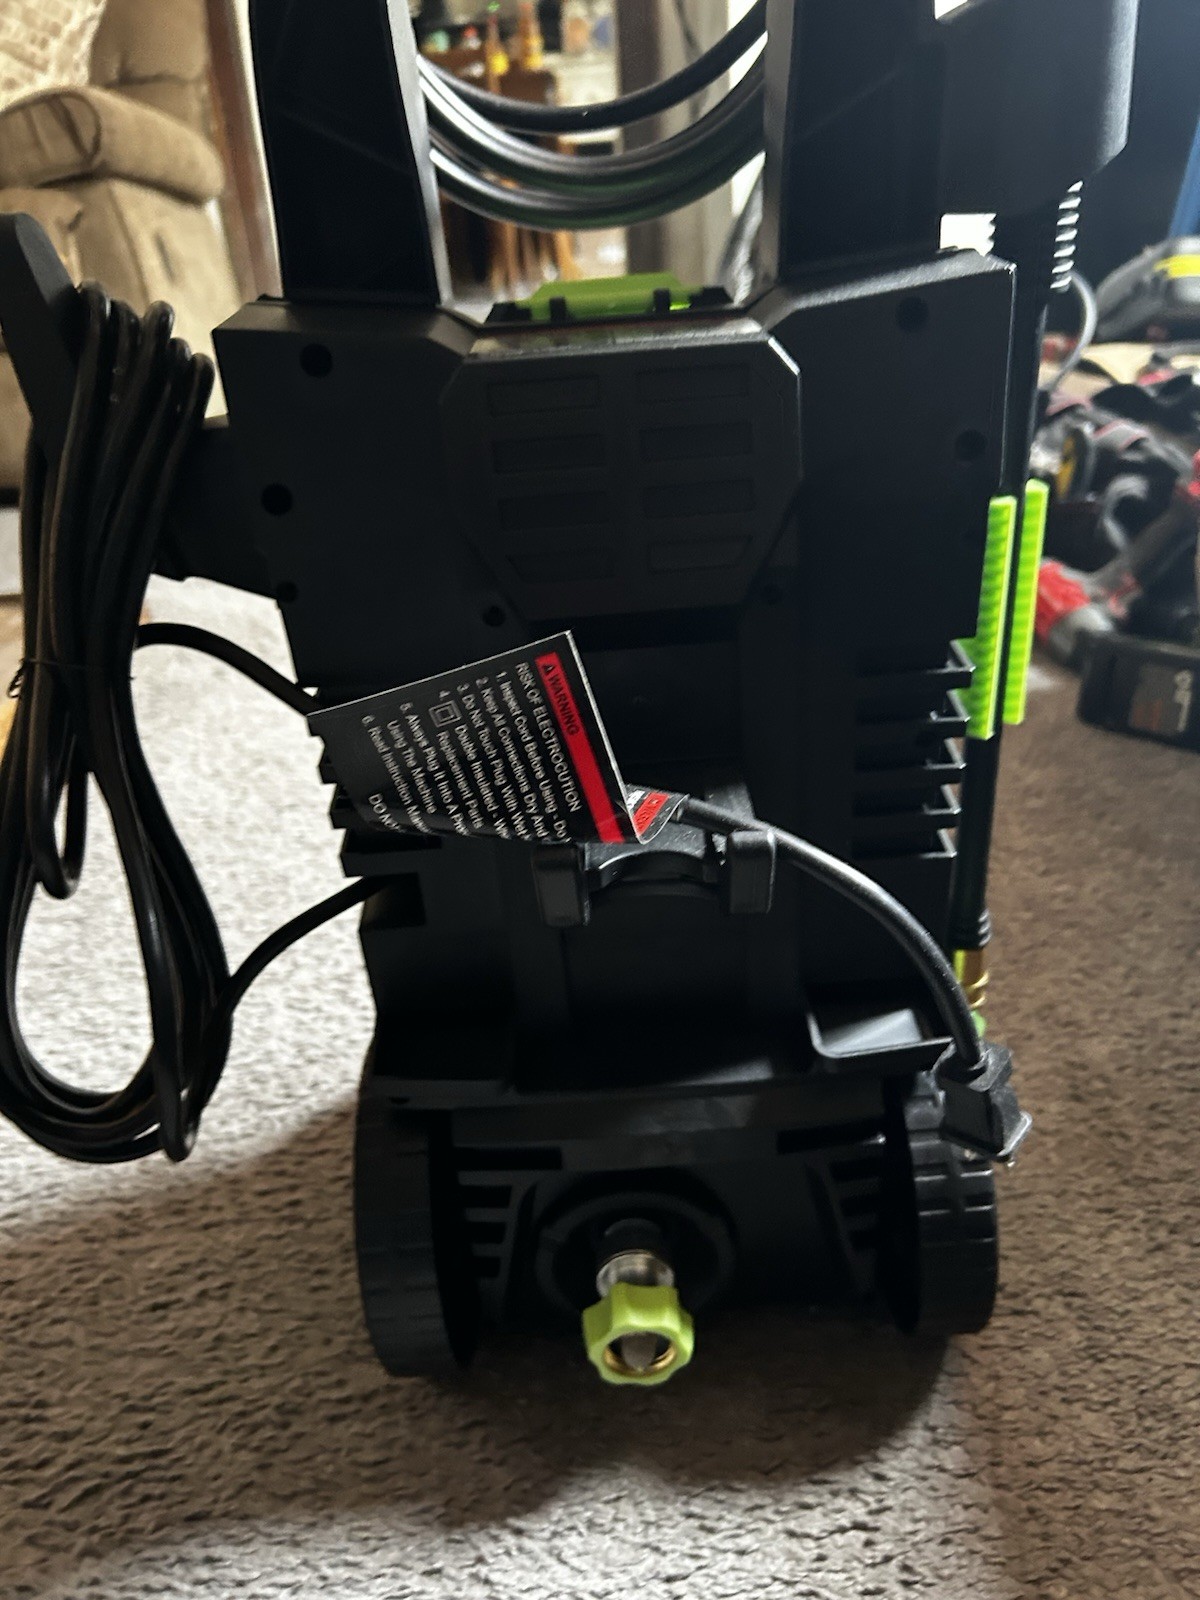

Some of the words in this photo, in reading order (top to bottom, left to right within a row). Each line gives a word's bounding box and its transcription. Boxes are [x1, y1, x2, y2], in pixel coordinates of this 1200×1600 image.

[475, 676, 489, 688] 2.
[495, 671, 508, 682] 1.
[514, 661, 536, 690] RISK
[461, 693, 477, 710] Do
[480, 687, 499, 714] Keep
[499, 680, 523, 717] Inspect
[526, 687, 543, 706] OF
[548, 673, 580, 736] WARNING
[404, 713, 429, 748] Always
[468, 708, 485, 728] Not
[491, 712, 507, 728] All
[514, 715, 534, 742] Cord
[477, 727, 498, 759] Touch
[367, 725, 391, 753] Read
[381, 751, 413, 805] Instruction
[386, 719, 407, 749] Using
[401, 747, 417, 768] The
[410, 766, 437, 814] Machine
[422, 746, 440, 772] Plug
[454, 723, 477, 761] Double
[470, 760, 499, 812] Insulated
[490, 758, 507, 786] Plug
[497, 726, 532, 793] Connections
[524, 741, 546, 780] Before
[532, 704, 582, 813] ELECTROCUTION
[433, 770, 446, 781] It
[436, 730, 474, 800] Replacement
[465, 798, 484, 829] Parts
[368, 793, 388, 815] DO
[437, 780, 454, 804] Into
[500, 784, 518, 812] With
[523, 792, 539, 814] Dry
[538, 778, 558, 814] Using
[445, 804, 459, 815] A
[511, 811, 528, 836] Wet
[530, 814, 549, 838] And
[553, 819, 567, 838] Do
